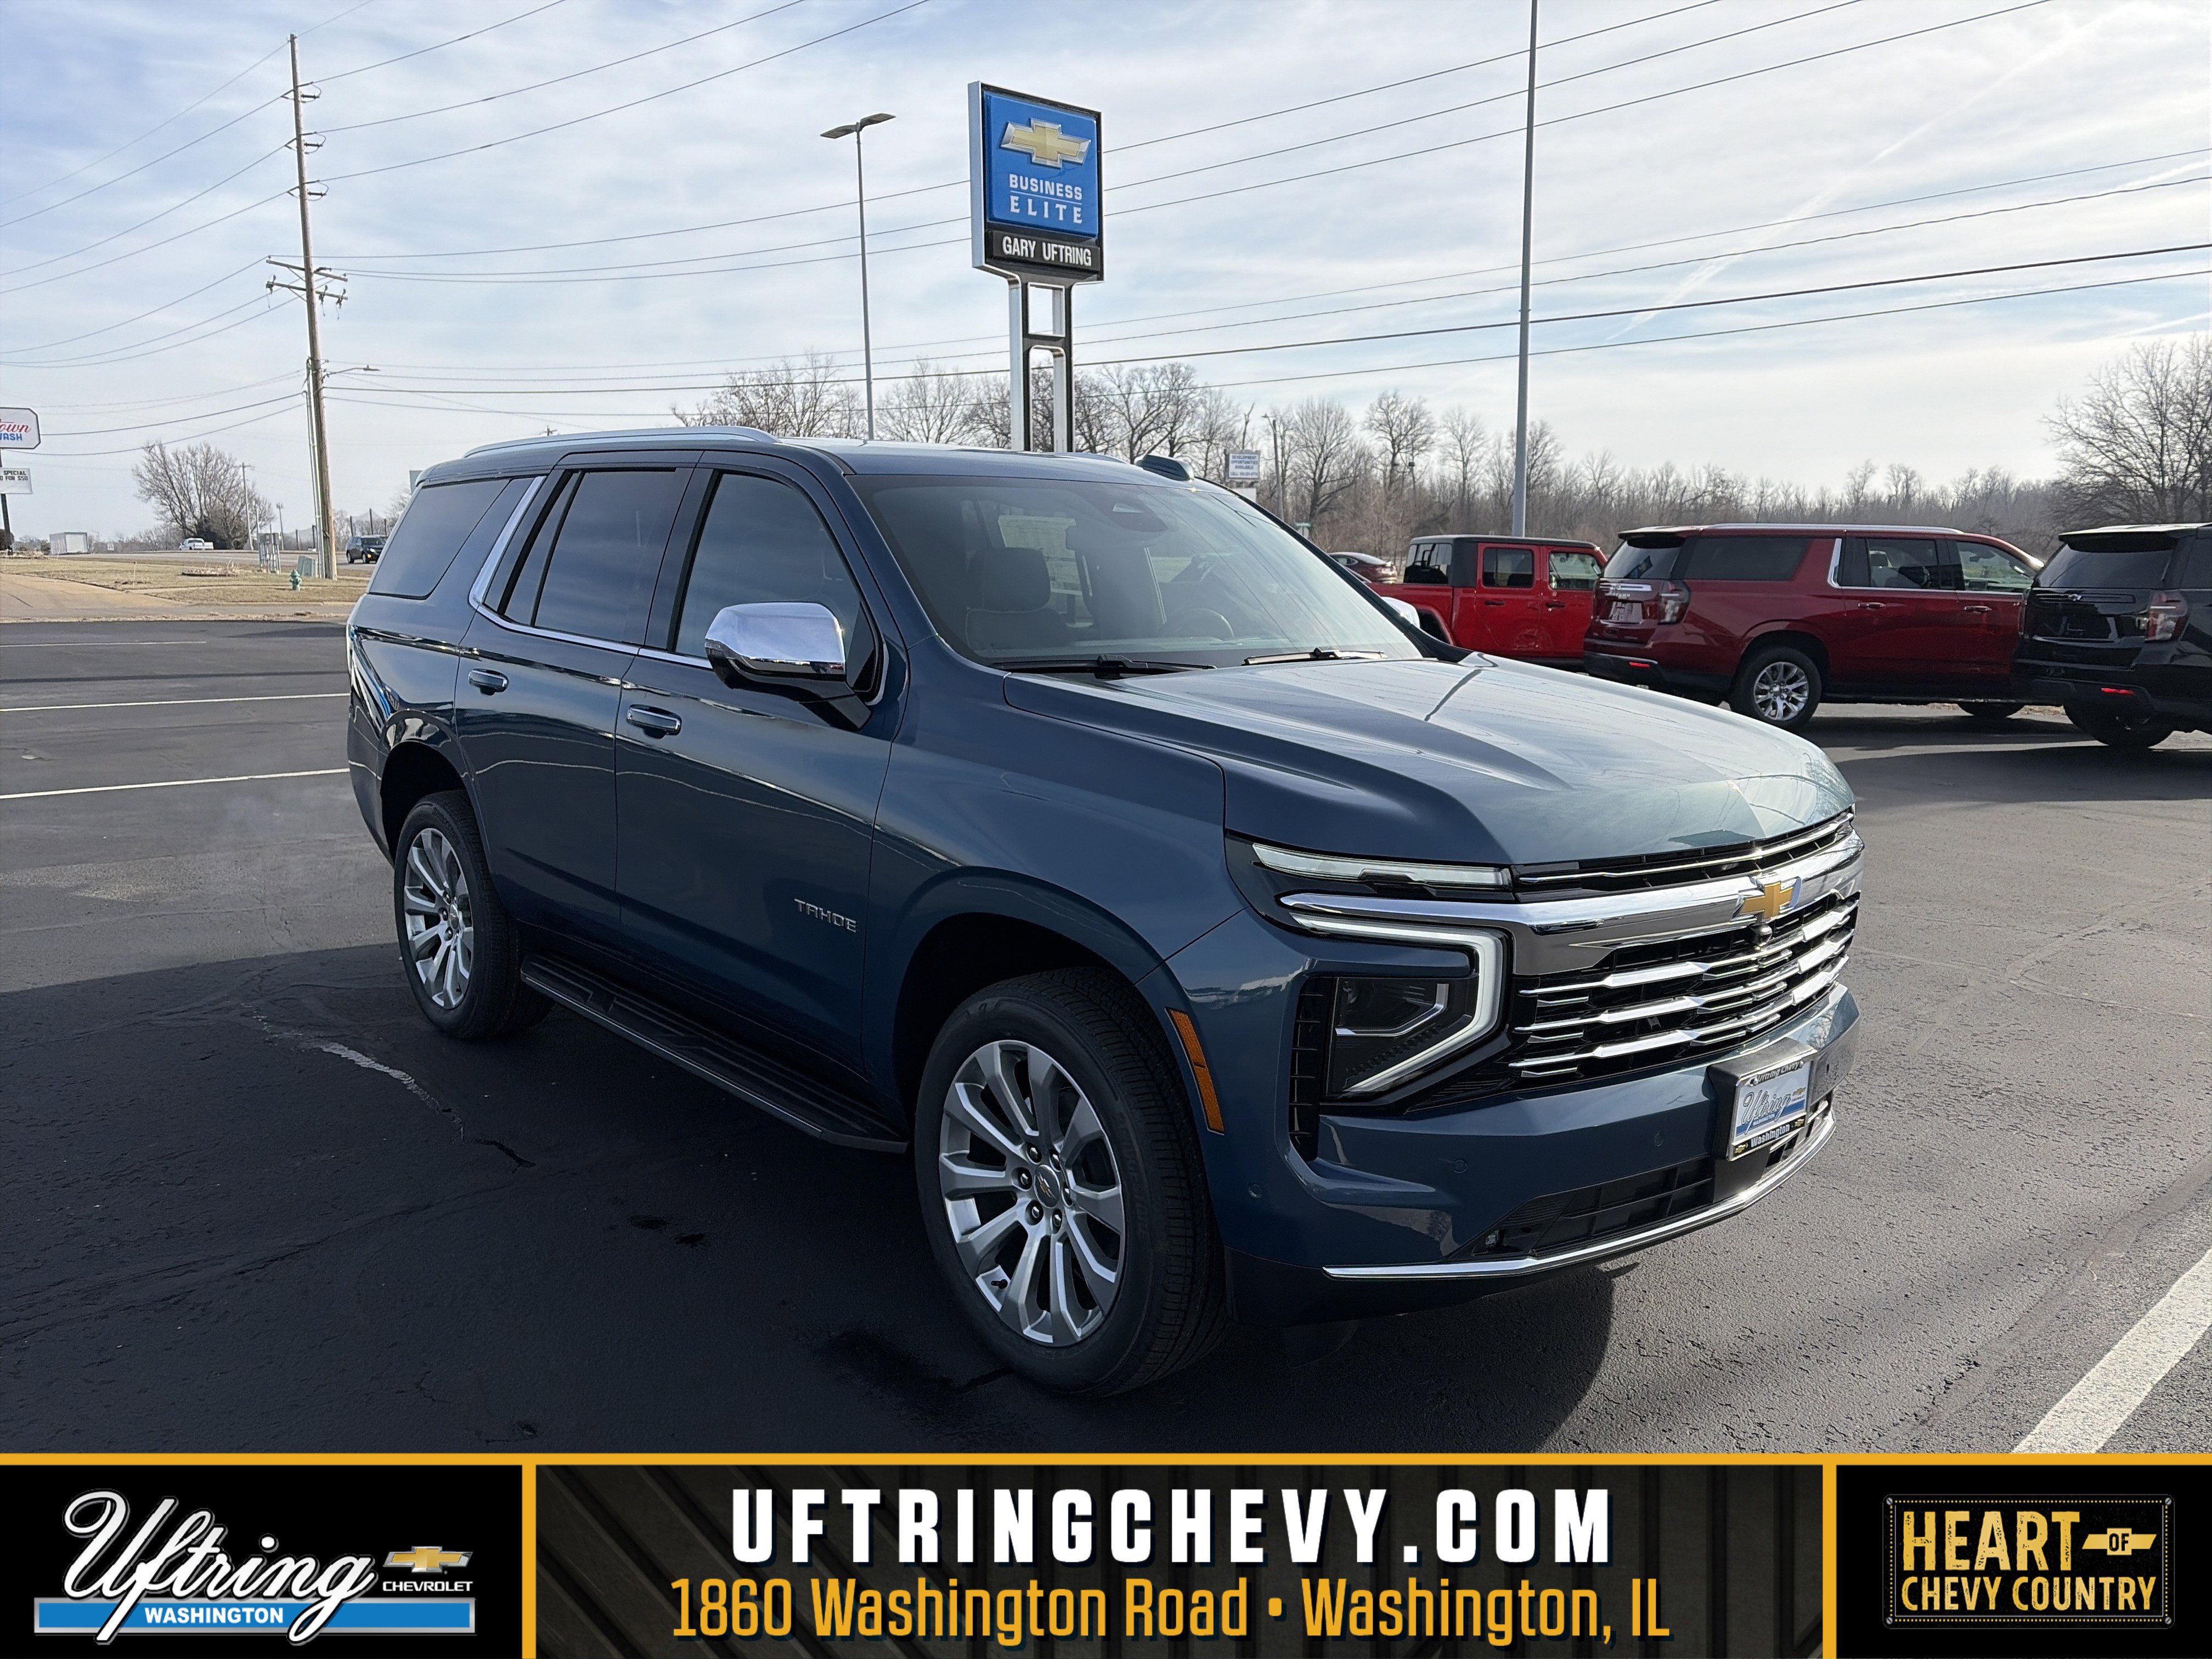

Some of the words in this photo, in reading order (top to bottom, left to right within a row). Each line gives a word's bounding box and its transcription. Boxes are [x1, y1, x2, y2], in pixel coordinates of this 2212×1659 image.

[1009, 173, 1082, 200] BUSINESS
[1010, 195, 1082, 224] ELITE
[1002, 236, 1036, 258] GARY
[1042, 242, 1092, 267] UFTRING
[794, 898, 856, 933] TAHOE
[1780, 1062, 1799, 1073] Chevy
[1741, 1090, 1791, 1135] Uftring
[1753, 1113, 1775, 1126] WASHINGTON
[1750, 1124, 1790, 1148] Washington
